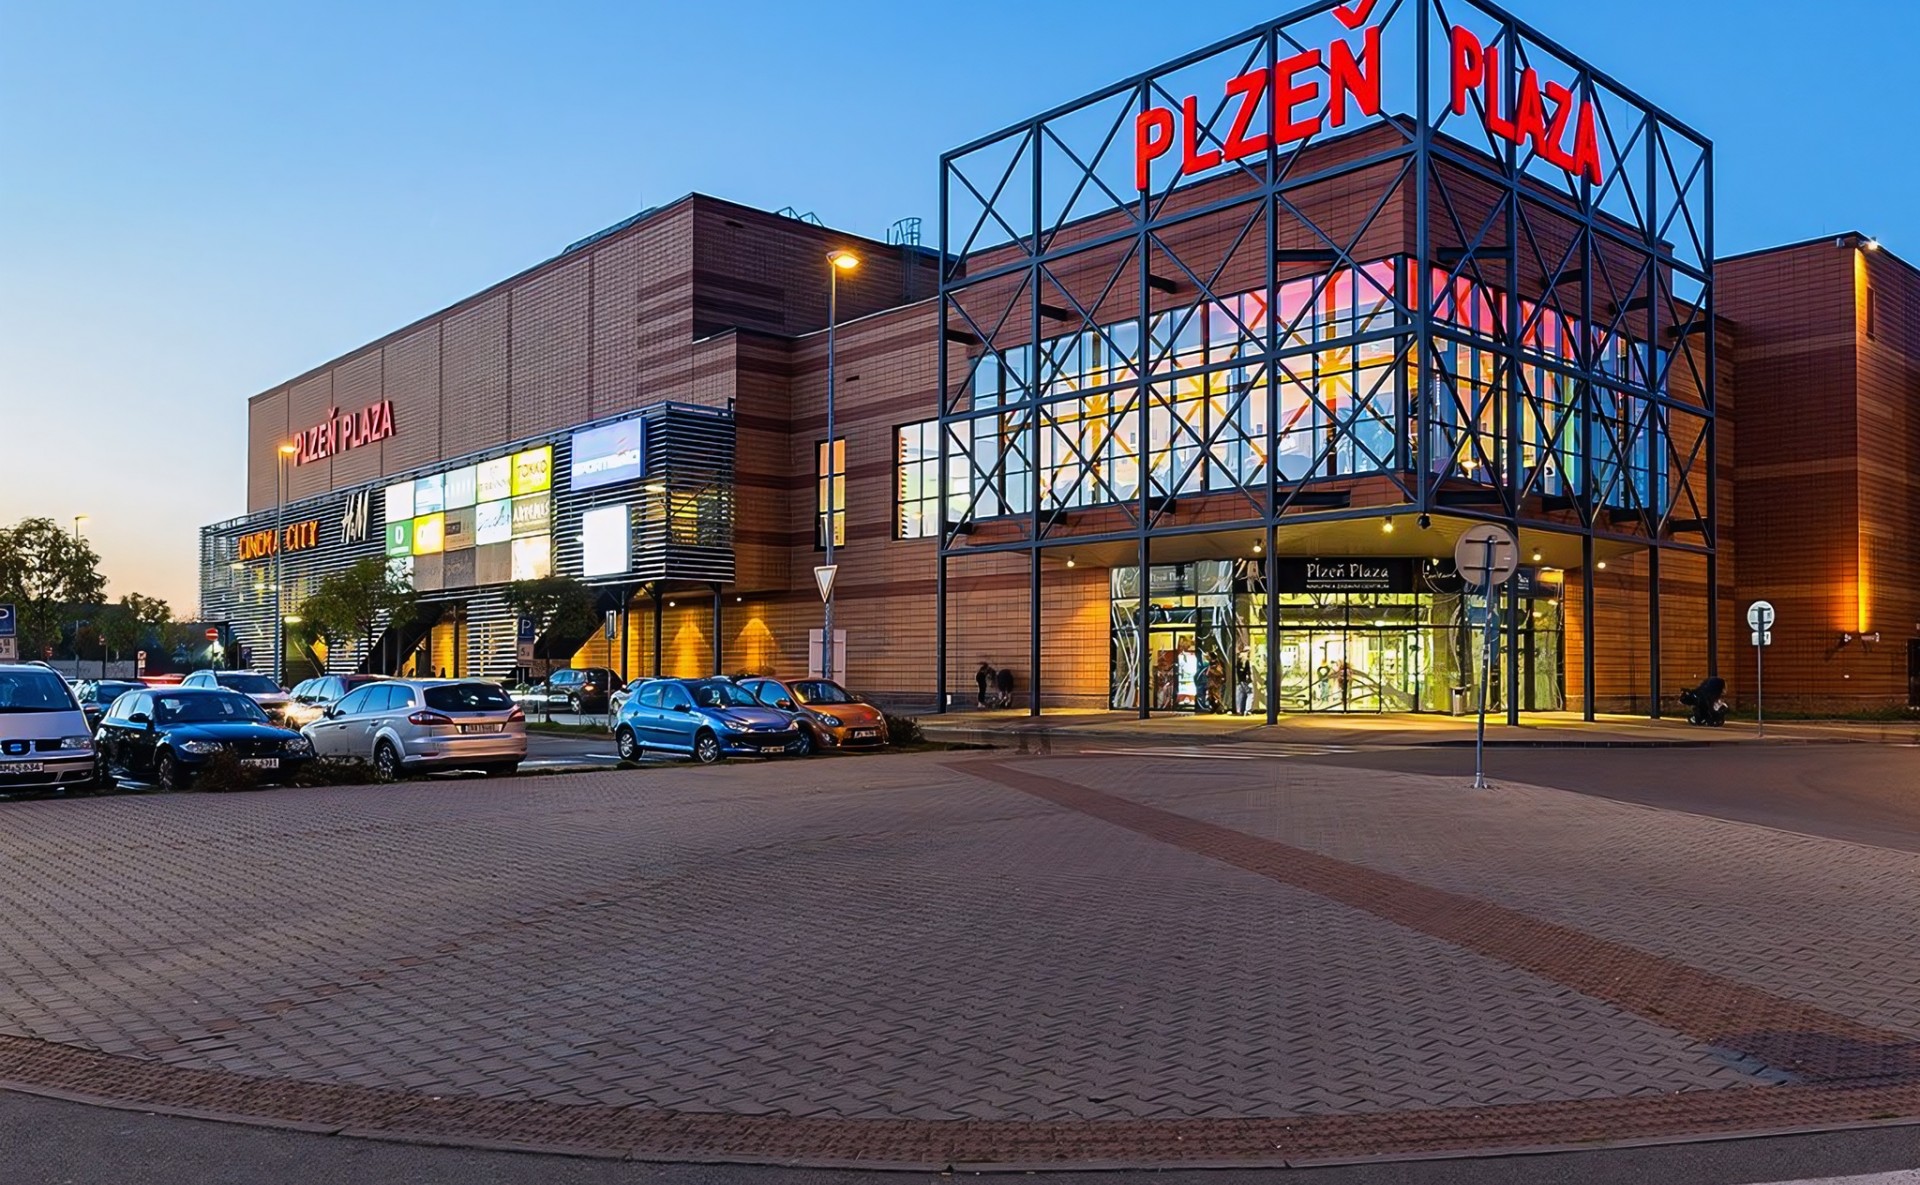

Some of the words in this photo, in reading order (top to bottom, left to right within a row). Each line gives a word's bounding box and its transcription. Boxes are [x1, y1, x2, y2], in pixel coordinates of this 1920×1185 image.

[1135, 0, 1381, 191] PLZEŇ
[1450, 24, 1604, 186] PLAZA
[293, 406, 339, 467] PLZEŇ
[342, 400, 396, 451] PLAZA
[286, 519, 320, 552] CITY
[1306, 563, 1345, 578] Plzeň
[1349, 563, 1389, 578] Plaza
[521, 619, 531, 634] P
